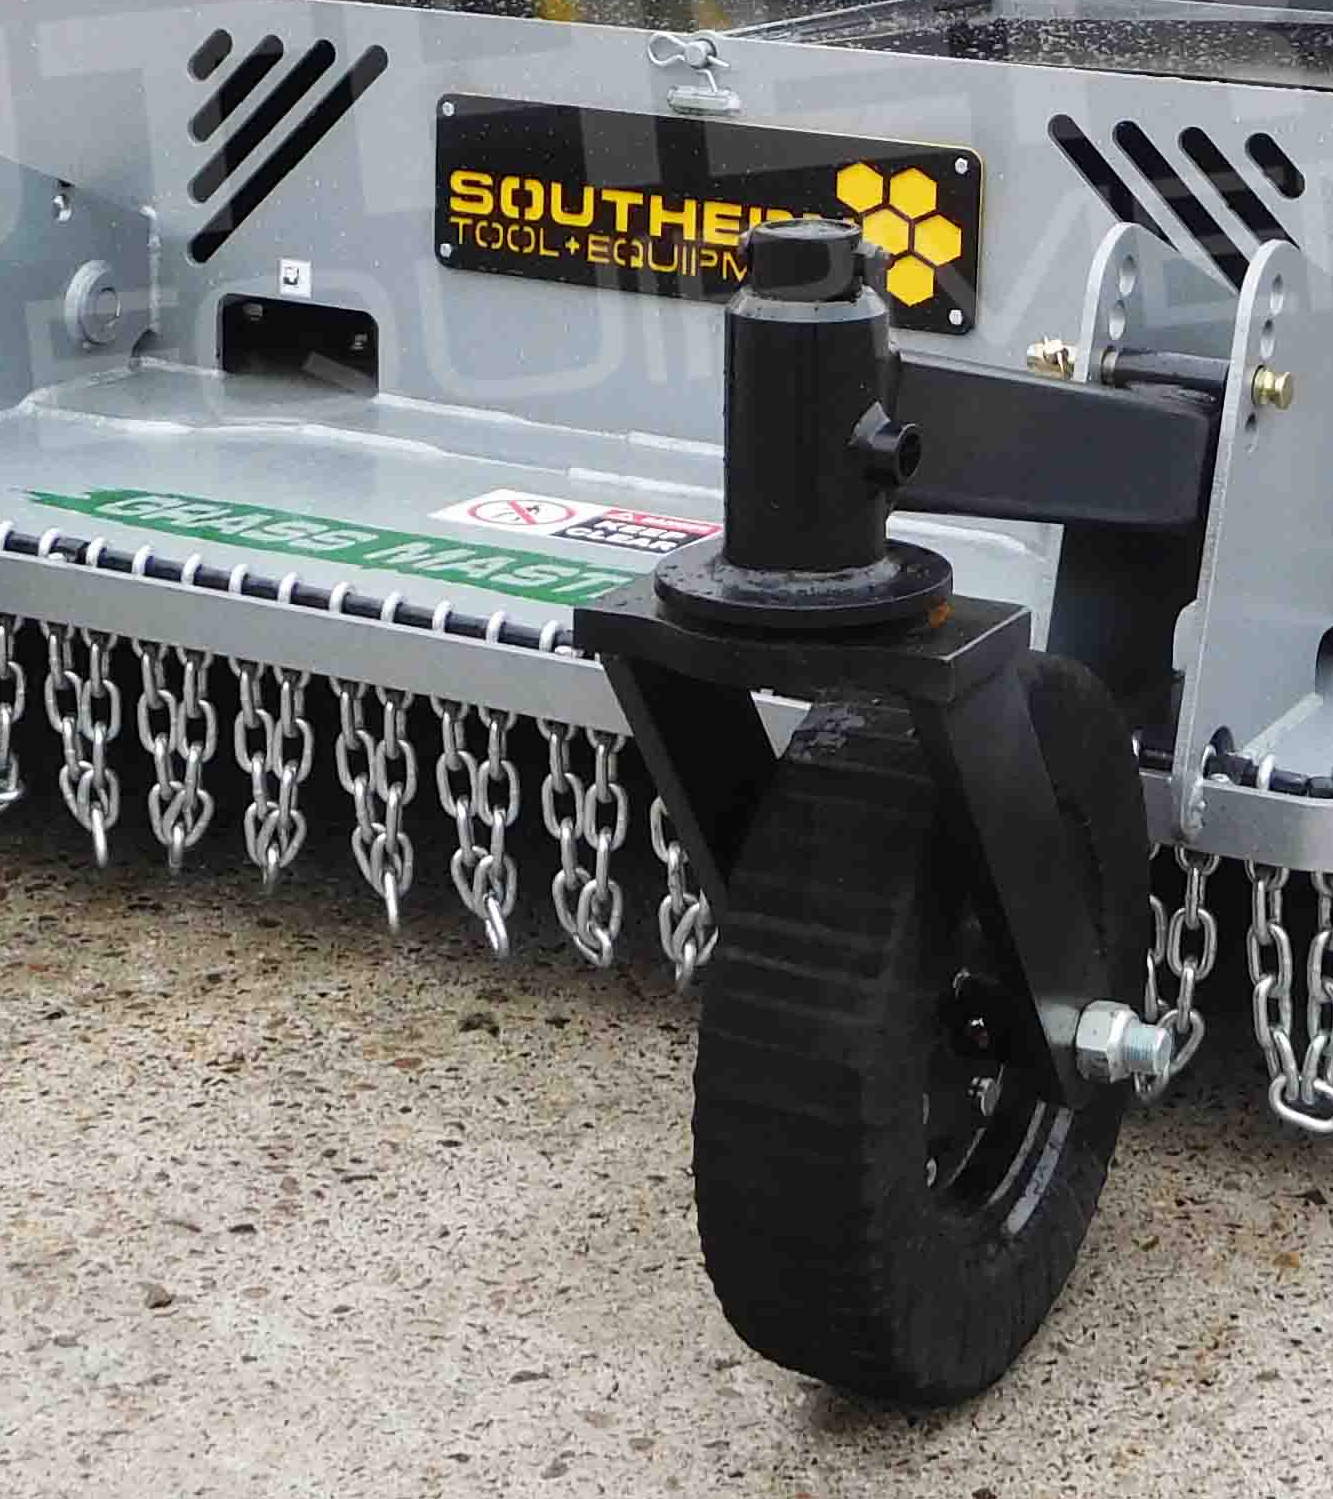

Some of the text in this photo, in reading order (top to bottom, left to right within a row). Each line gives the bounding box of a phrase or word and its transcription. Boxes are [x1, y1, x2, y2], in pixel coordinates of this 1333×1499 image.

[108, 493, 378, 554] GRASS
[594, 520, 688, 540] KEEP
[565, 527, 679, 551] CLEAR
